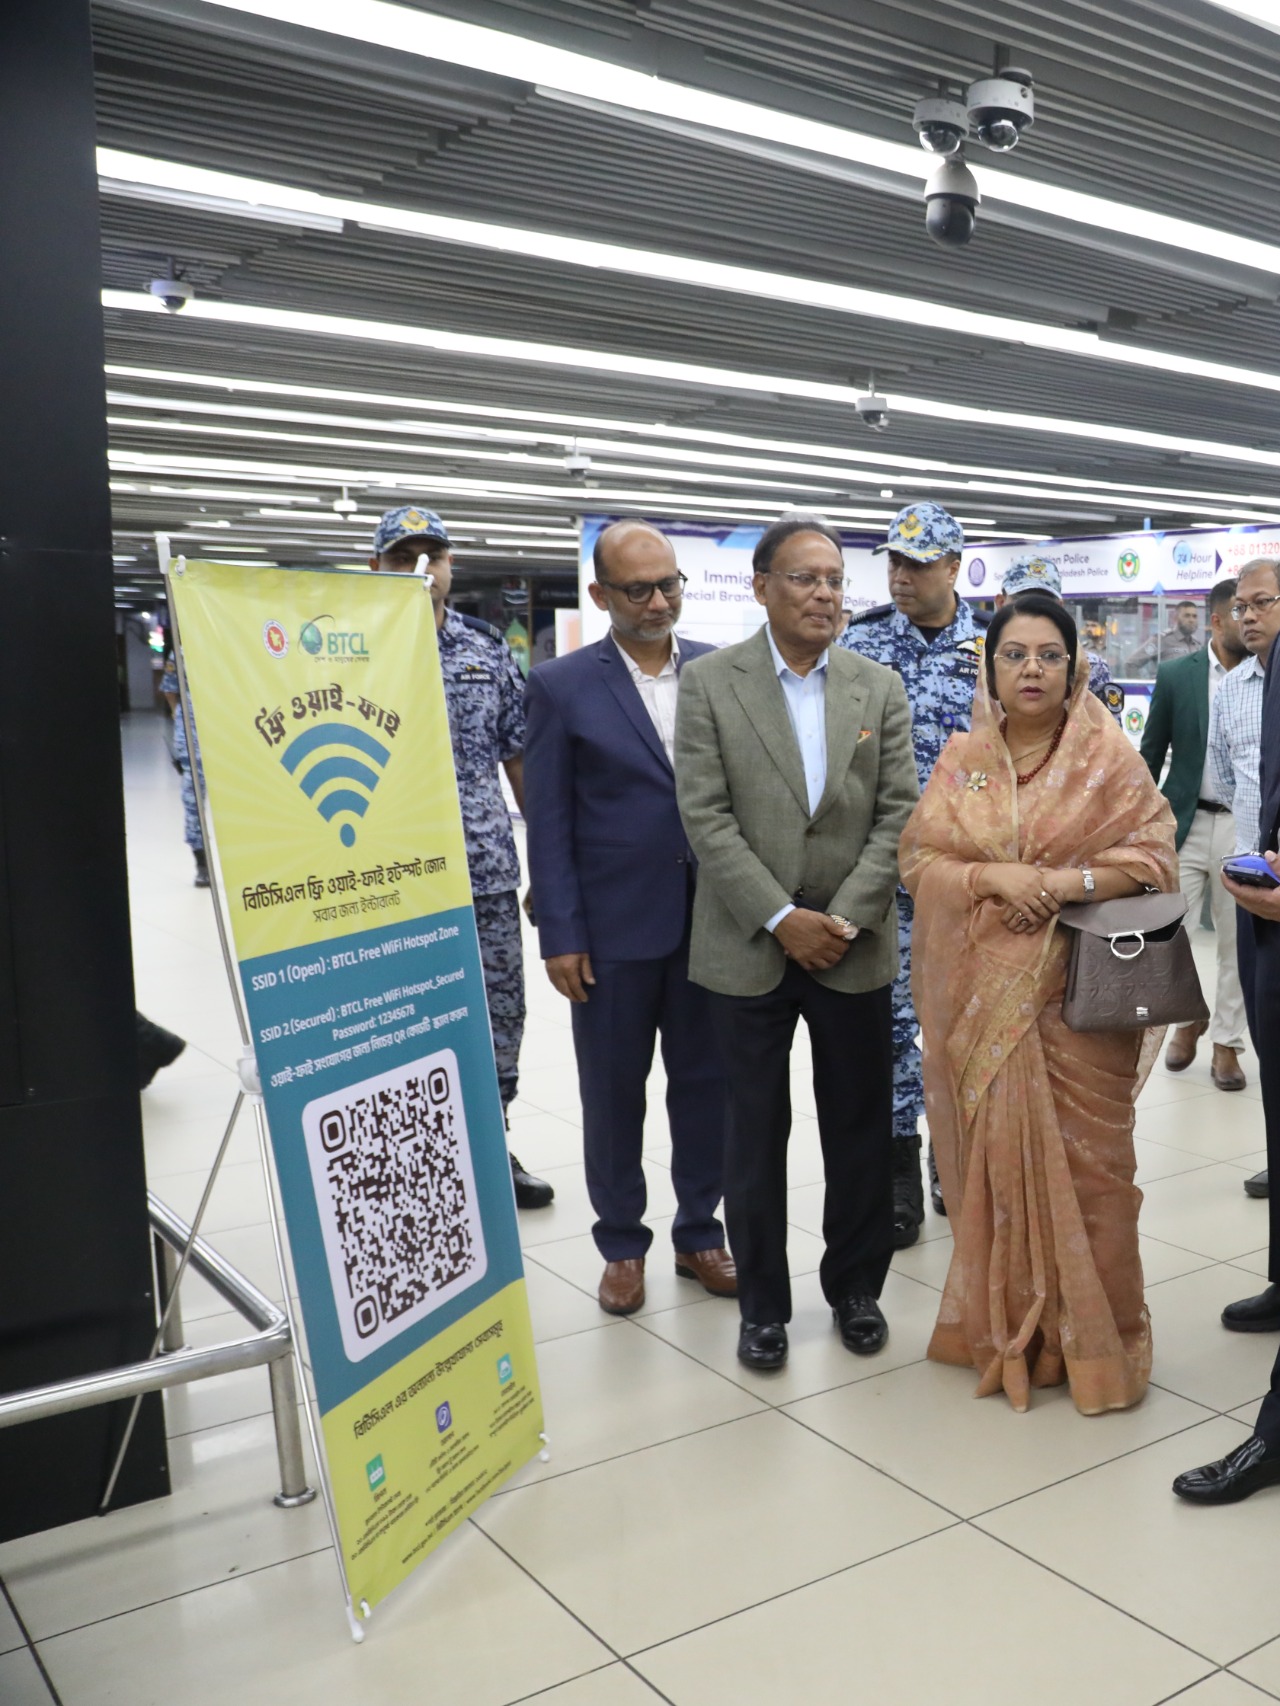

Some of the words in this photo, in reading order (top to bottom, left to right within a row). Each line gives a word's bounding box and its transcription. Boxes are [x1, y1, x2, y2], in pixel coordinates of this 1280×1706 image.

[1064, 554, 1090, 565] Police
[1189, 552, 1212, 563] Hour
[704, 569, 754, 588] Immig
[1059, 569, 1085, 579] gladesh
[1087, 568, 1109, 578] Police
[1176, 569, 1213, 581] Helpline
[682, 590, 716, 602] ecial
[719, 590, 757, 604] Branc
[844, 596, 878, 608] Police
[327, 632, 369, 655] BTCL
[254, 705, 287, 748] ফ্রি
[242, 882, 306, 911] বিটিসিএল
[307, 875, 325, 900] ফ্রি
[327, 865, 385, 895] ওয়াই-ফাই
[386, 858, 422, 883] হটস্পট
[424, 857, 447, 875] জোন
[312, 906, 338, 922] সবার
[338, 902, 359, 917] জন্য
[360, 890, 401, 912] ইন্টারনেট
[251, 972, 277, 991] SSID
[278, 969, 286, 983] 1
[286, 956, 326, 983] (Open)
[331, 951, 358, 969] BTCL
[358, 946, 381, 962] Free
[381, 938, 403, 956] WiFi
[403, 930, 438, 948] Hotspot
[438, 926, 459, 940] Zone
[260, 1025, 282, 1043] SSID
[282, 1022, 290, 1036] 2
[290, 1006, 336, 1035] (Secured)
[340, 1000, 363, 1018] BTCL
[363, 995, 383, 1010] Free
[383, 987, 402, 1003] WiFi
[402, 967, 465, 997] Hotspot_Secured
[332, 1016, 377, 1041] Password:
[378, 1003, 415, 1025] 12345678
[270, 1059, 314, 1087] ওয়াই-ফাই
[314, 1048, 352, 1071] সংযোগের
[352, 1042, 370, 1058] জন্য
[370, 1035, 393, 1051] নিচের
[393, 1029, 406, 1044] QR
[406, 1016, 431, 1038] কোডটি
[449, 1006, 468, 1022] করুন
[353, 1401, 394, 1439] বিটিসিএল
[394, 1390, 408, 1408] এর
[407, 1369, 436, 1398] অন্যান্য
